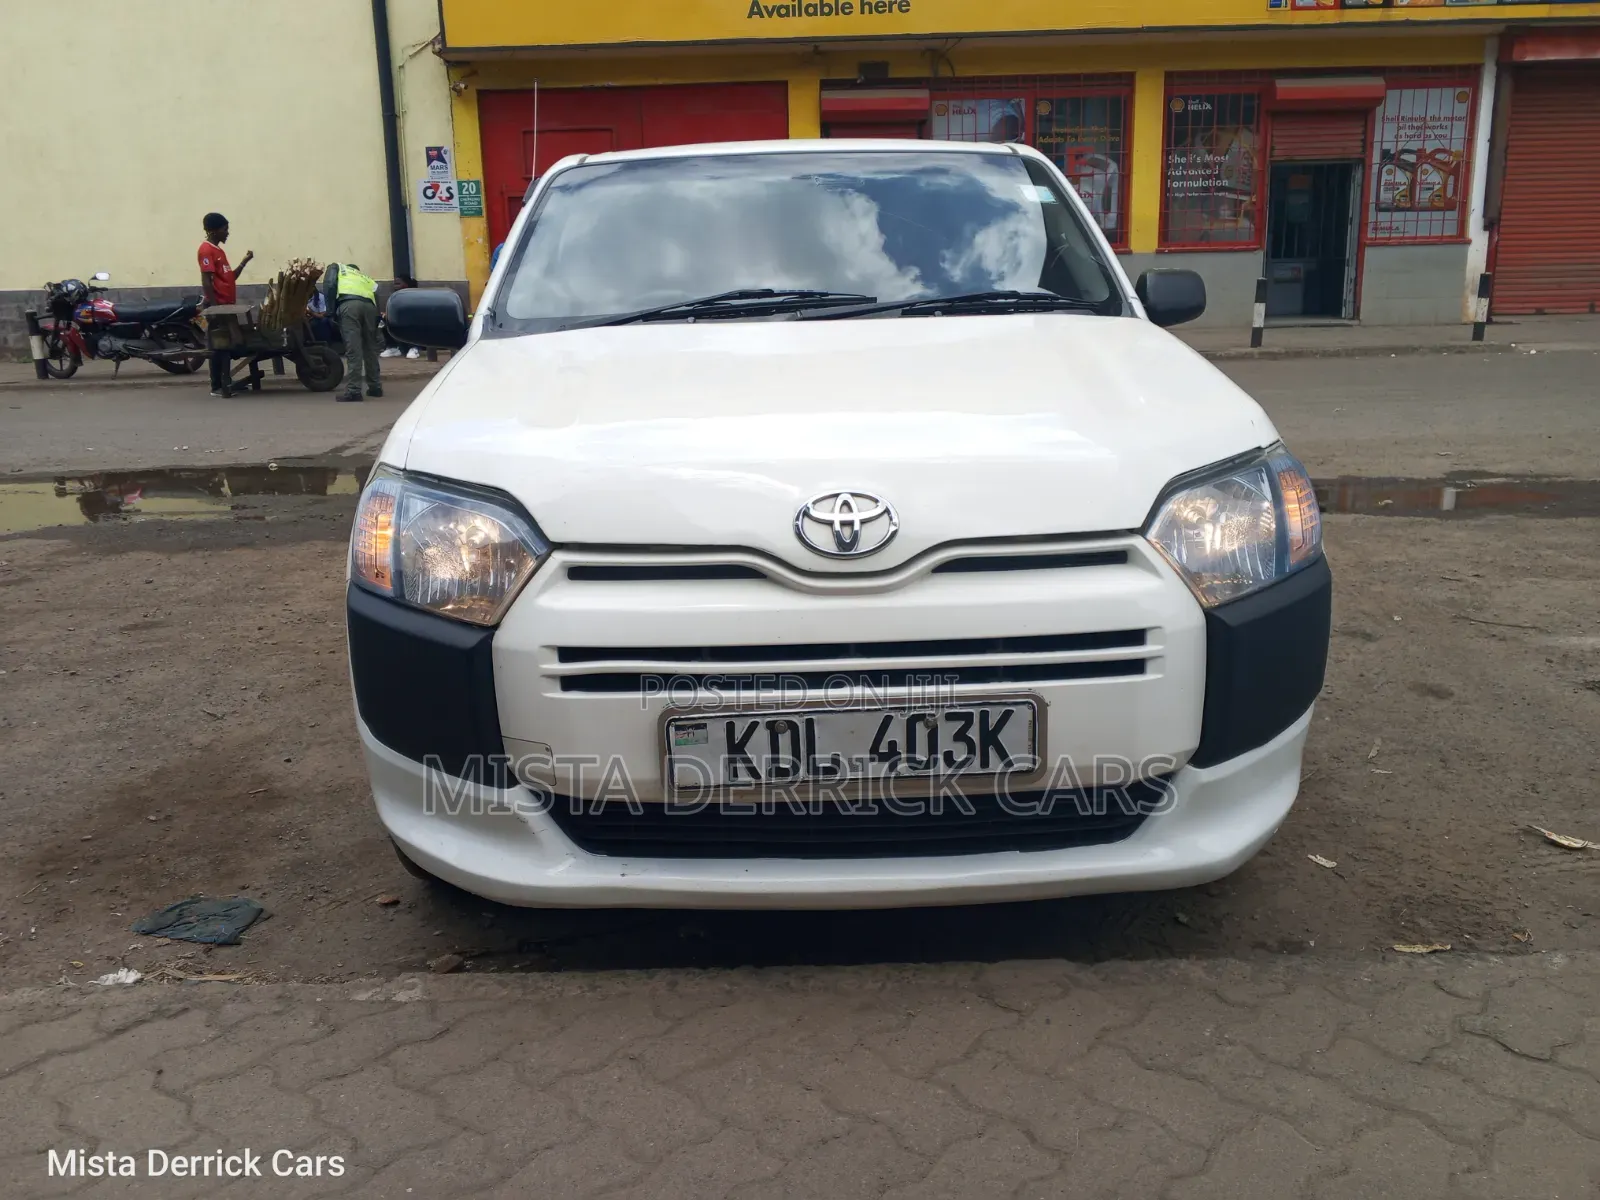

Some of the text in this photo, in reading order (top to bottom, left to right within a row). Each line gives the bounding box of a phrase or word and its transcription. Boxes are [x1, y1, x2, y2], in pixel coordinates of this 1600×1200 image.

[747, 0, 911, 18] Available here
[1204, 153, 1229, 163] Most
[461, 182, 476, 194] 20
[724, 717, 841, 781] KDL
[868, 708, 1016, 773] 403K
